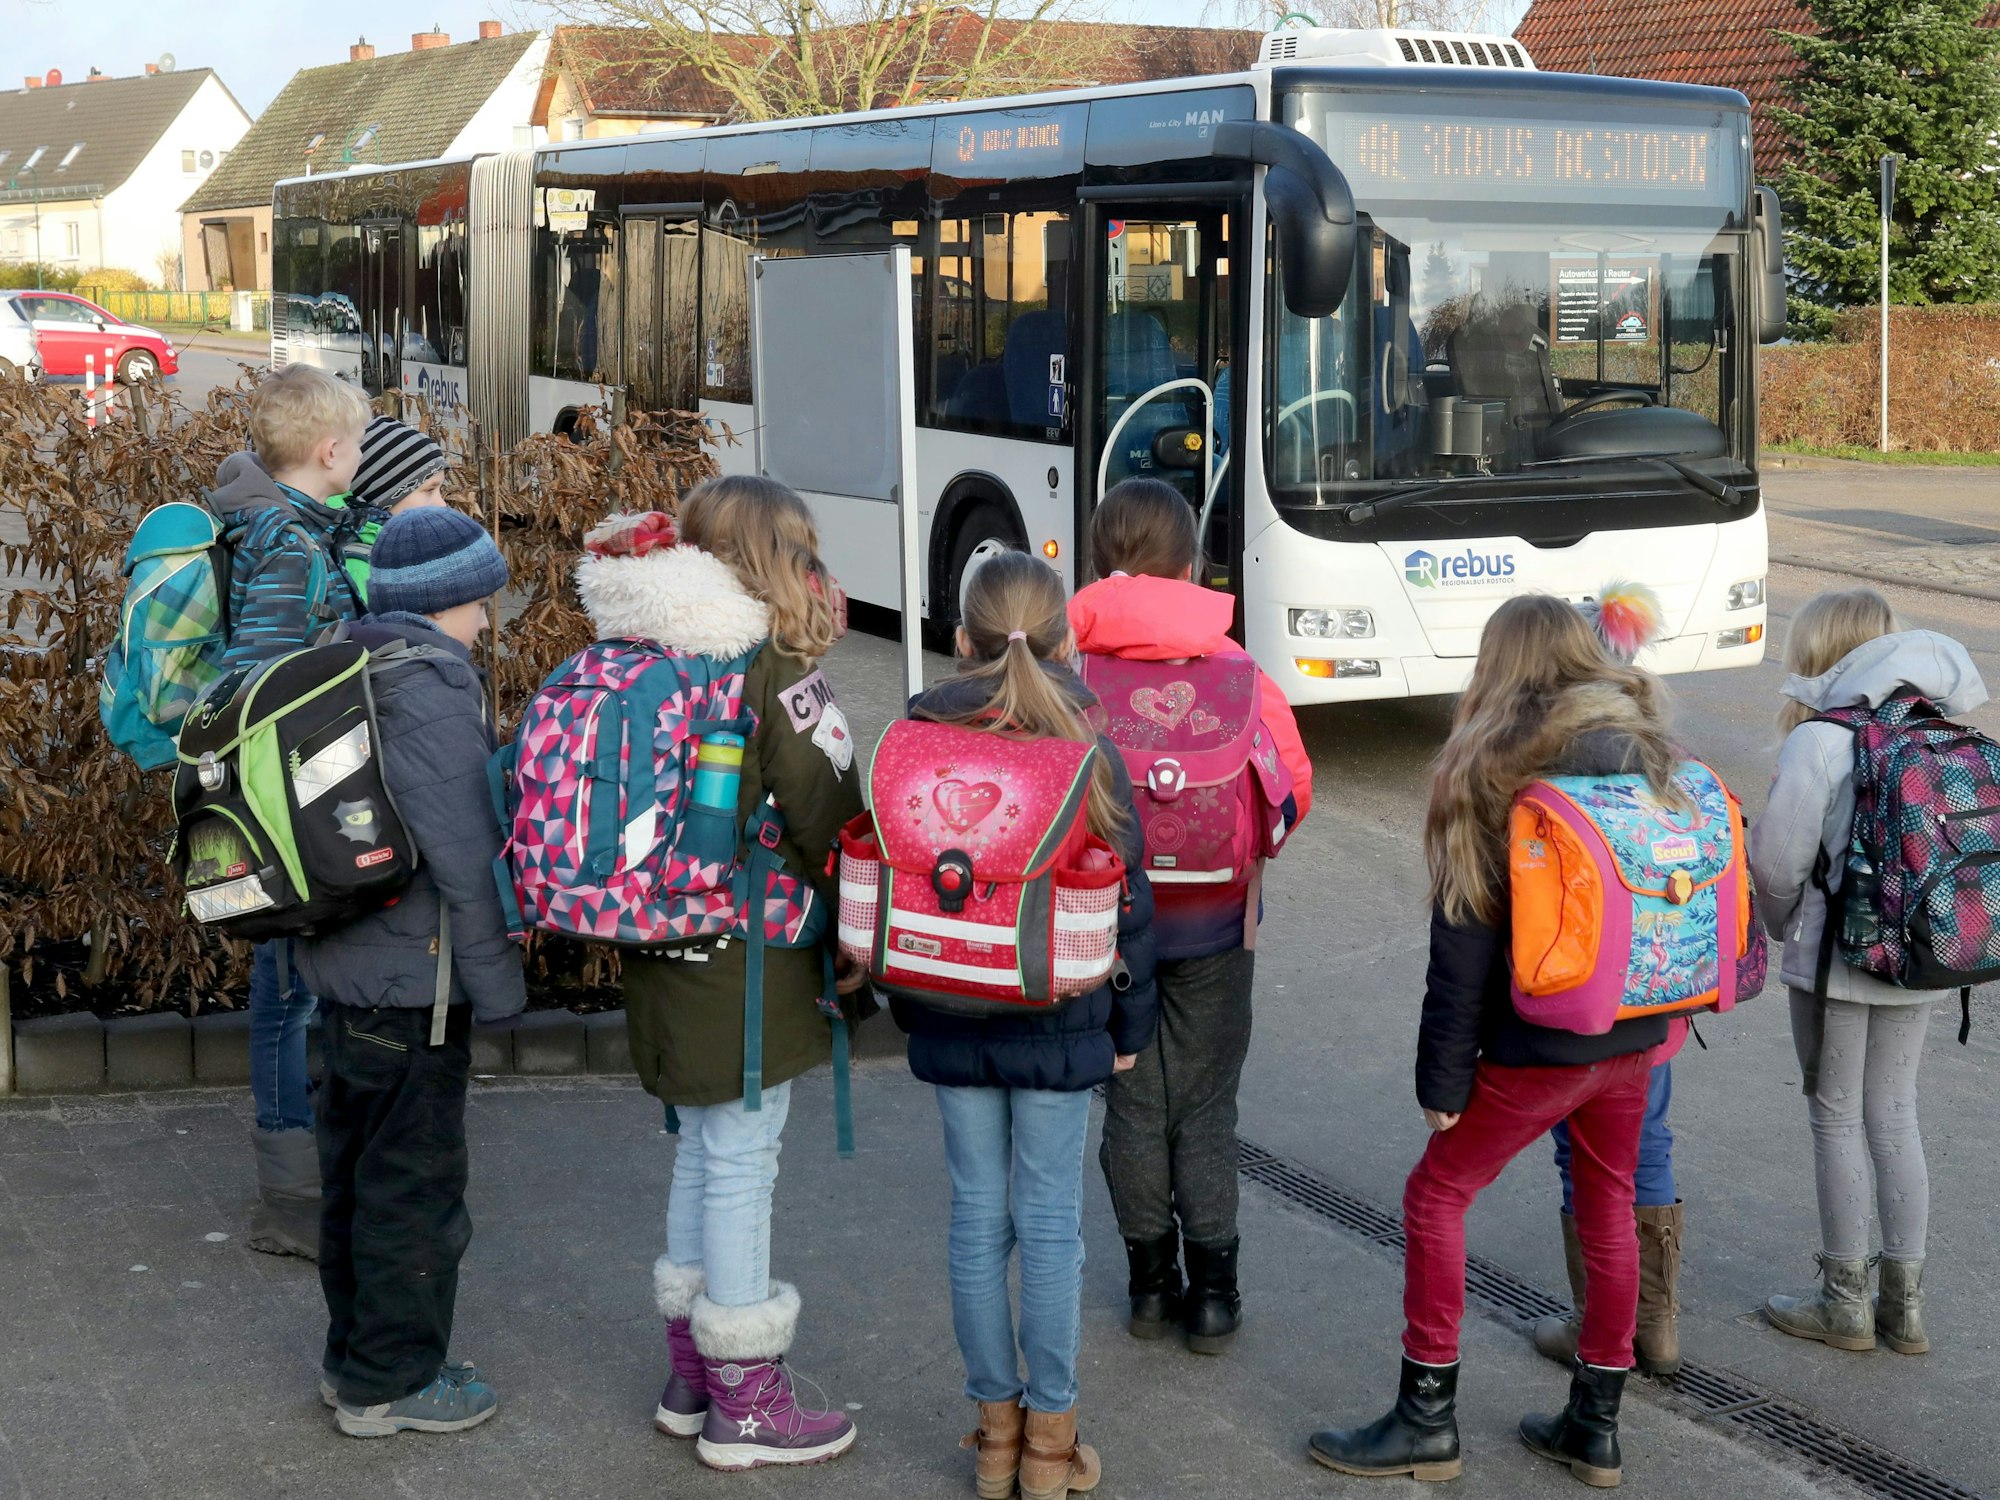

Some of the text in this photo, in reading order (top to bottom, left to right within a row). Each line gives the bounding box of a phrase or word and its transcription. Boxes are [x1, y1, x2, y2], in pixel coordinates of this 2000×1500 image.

[1149, 119, 1182, 129] Lion's City
[1185, 109, 1224, 126] MAN
[1608, 269, 1631, 278] Reuter
[431, 369, 460, 409] rebus
[1130, 450, 1151, 459] MA
[1441, 548, 1516, 578] rebus
[1441, 577, 1516, 586] REGIONALBUS ROSTOCK
[1654, 844, 1694, 861] Scout
